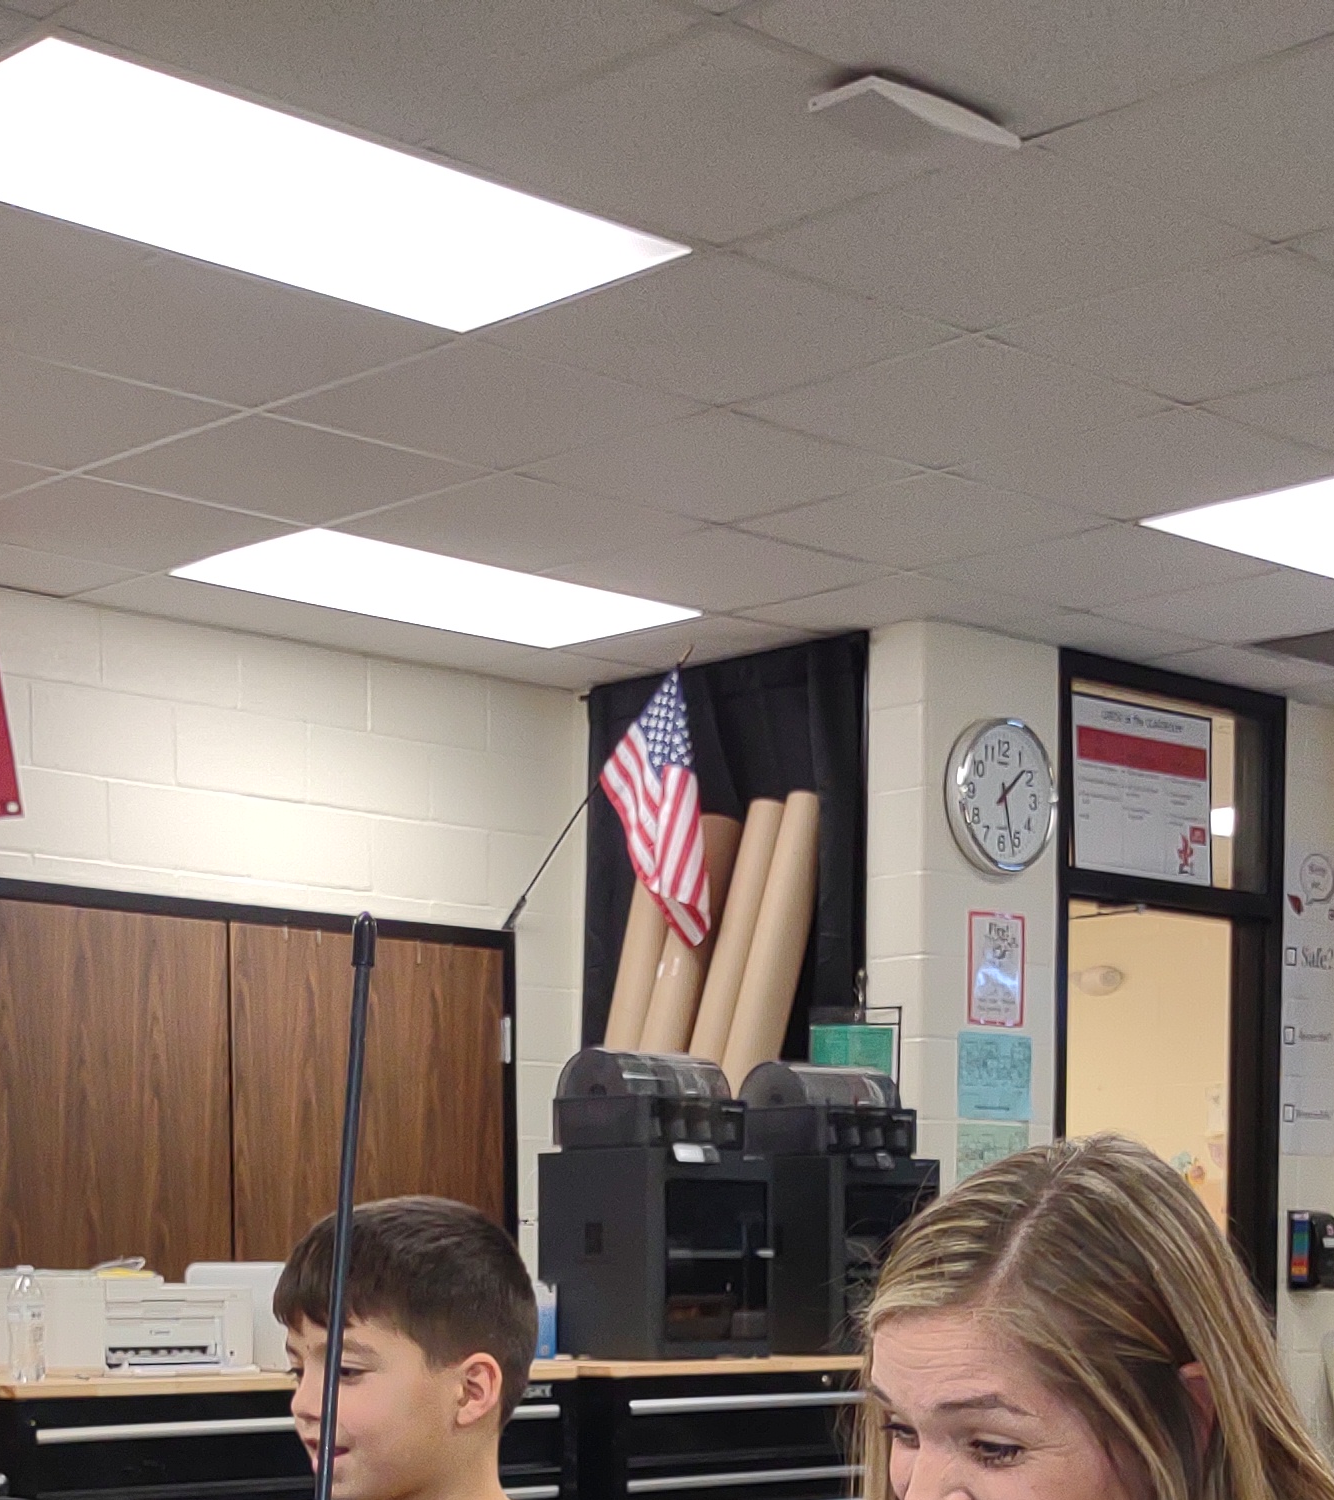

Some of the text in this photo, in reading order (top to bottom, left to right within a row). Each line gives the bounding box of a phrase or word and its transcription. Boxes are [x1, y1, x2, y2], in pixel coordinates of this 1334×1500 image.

[984, 743, 995, 762] 11
[998, 739, 1010, 758] 12
[1017, 750, 1022, 767] 1
[973, 760, 985, 777] 10
[1025, 770, 1034, 787] 2
[967, 782, 976, 799] 9
[1029, 794, 1038, 810] 3
[971, 807, 981, 824] 8
[1024, 817, 1032, 832] 4
[982, 825, 990, 842] 7
[1012, 832, 1021, 848] 5
[997, 835, 1006, 852] 6
